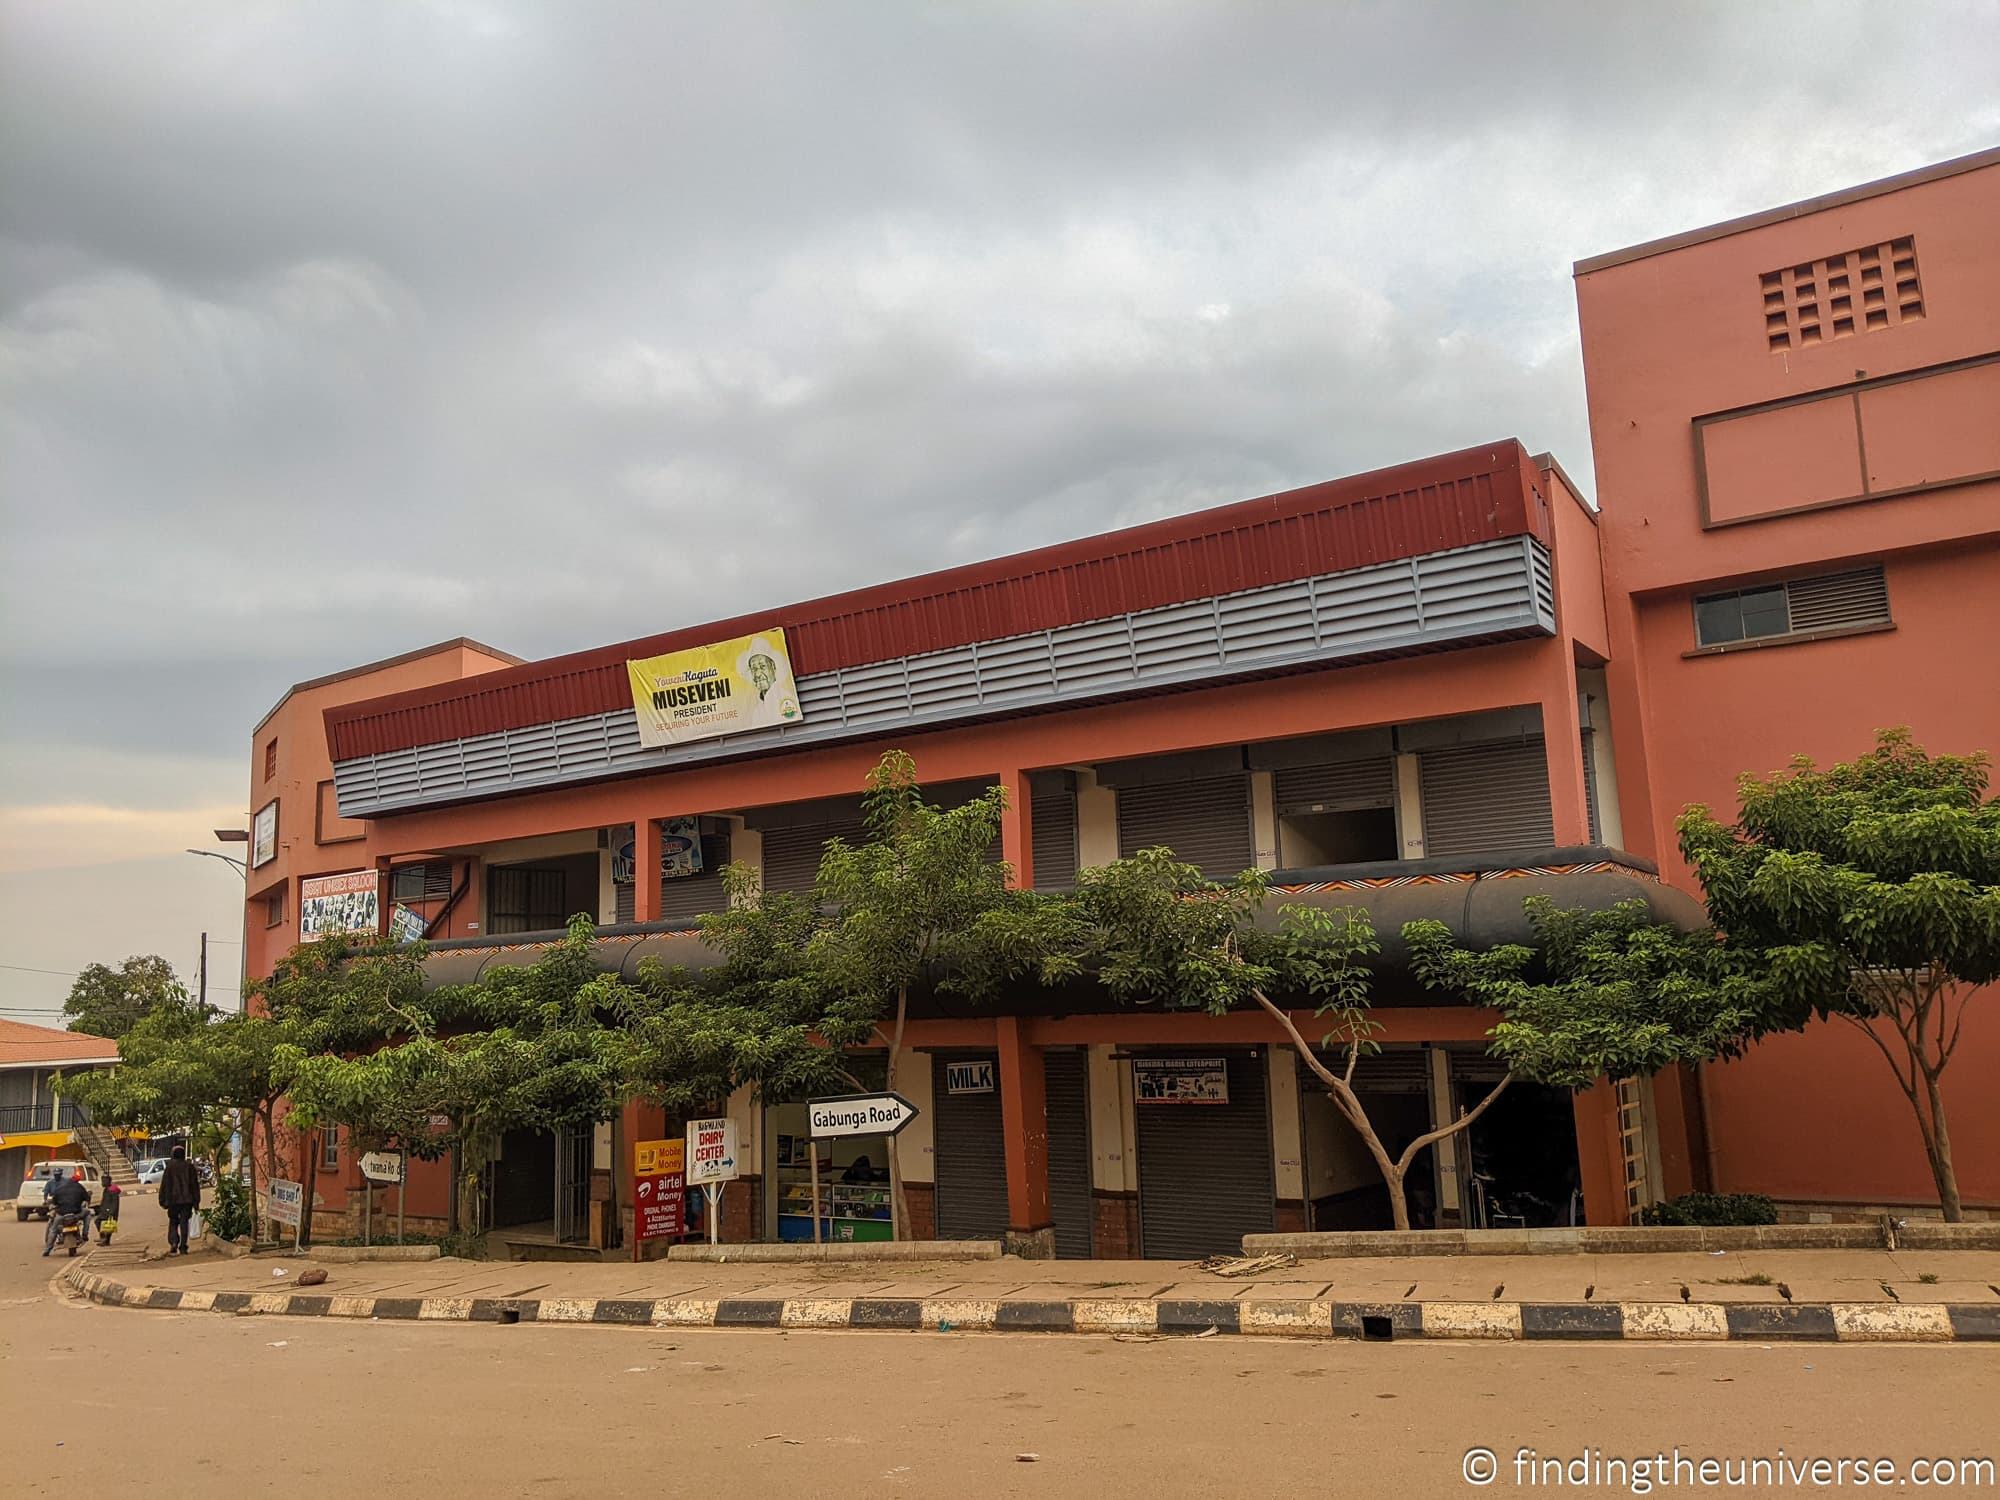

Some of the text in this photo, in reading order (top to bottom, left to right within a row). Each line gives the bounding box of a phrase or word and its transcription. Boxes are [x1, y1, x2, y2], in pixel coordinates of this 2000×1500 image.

[683, 668, 718, 682] Kaguta
[652, 678, 731, 711] MUSEVENI
[673, 703, 717, 719] PRESIDENT
[655, 710, 738, 732] SECURING YOUR FUTURE
[948, 1066, 993, 1089] MILK
[813, 1103, 901, 1128] Gabunga Road
[699, 1130, 724, 1145] DAIRY
[659, 1147, 681, 1157] Mobile
[695, 1145, 724, 1161] CENTER
[658, 1158, 681, 1169] Money
[658, 1175, 682, 1190] airtel
[657, 1192, 683, 1201] Money
